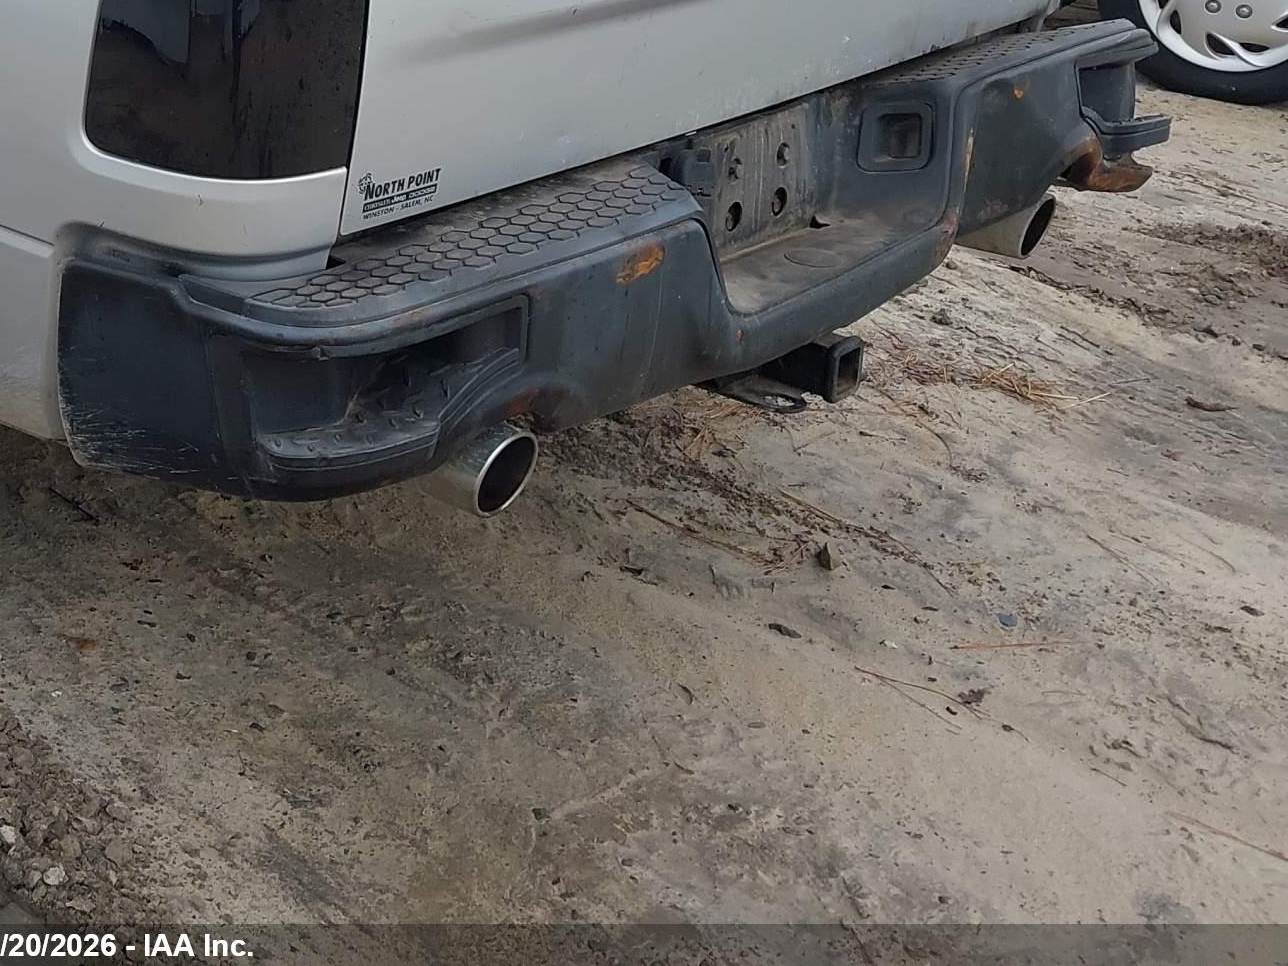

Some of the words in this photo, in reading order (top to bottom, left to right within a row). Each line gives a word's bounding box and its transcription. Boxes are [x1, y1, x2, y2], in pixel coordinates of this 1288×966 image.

[364, 178, 406, 201] NORTH
[407, 168, 441, 188] POINT
[363, 206, 395, 220] WINSTON
[424, 195, 434, 203] NC
